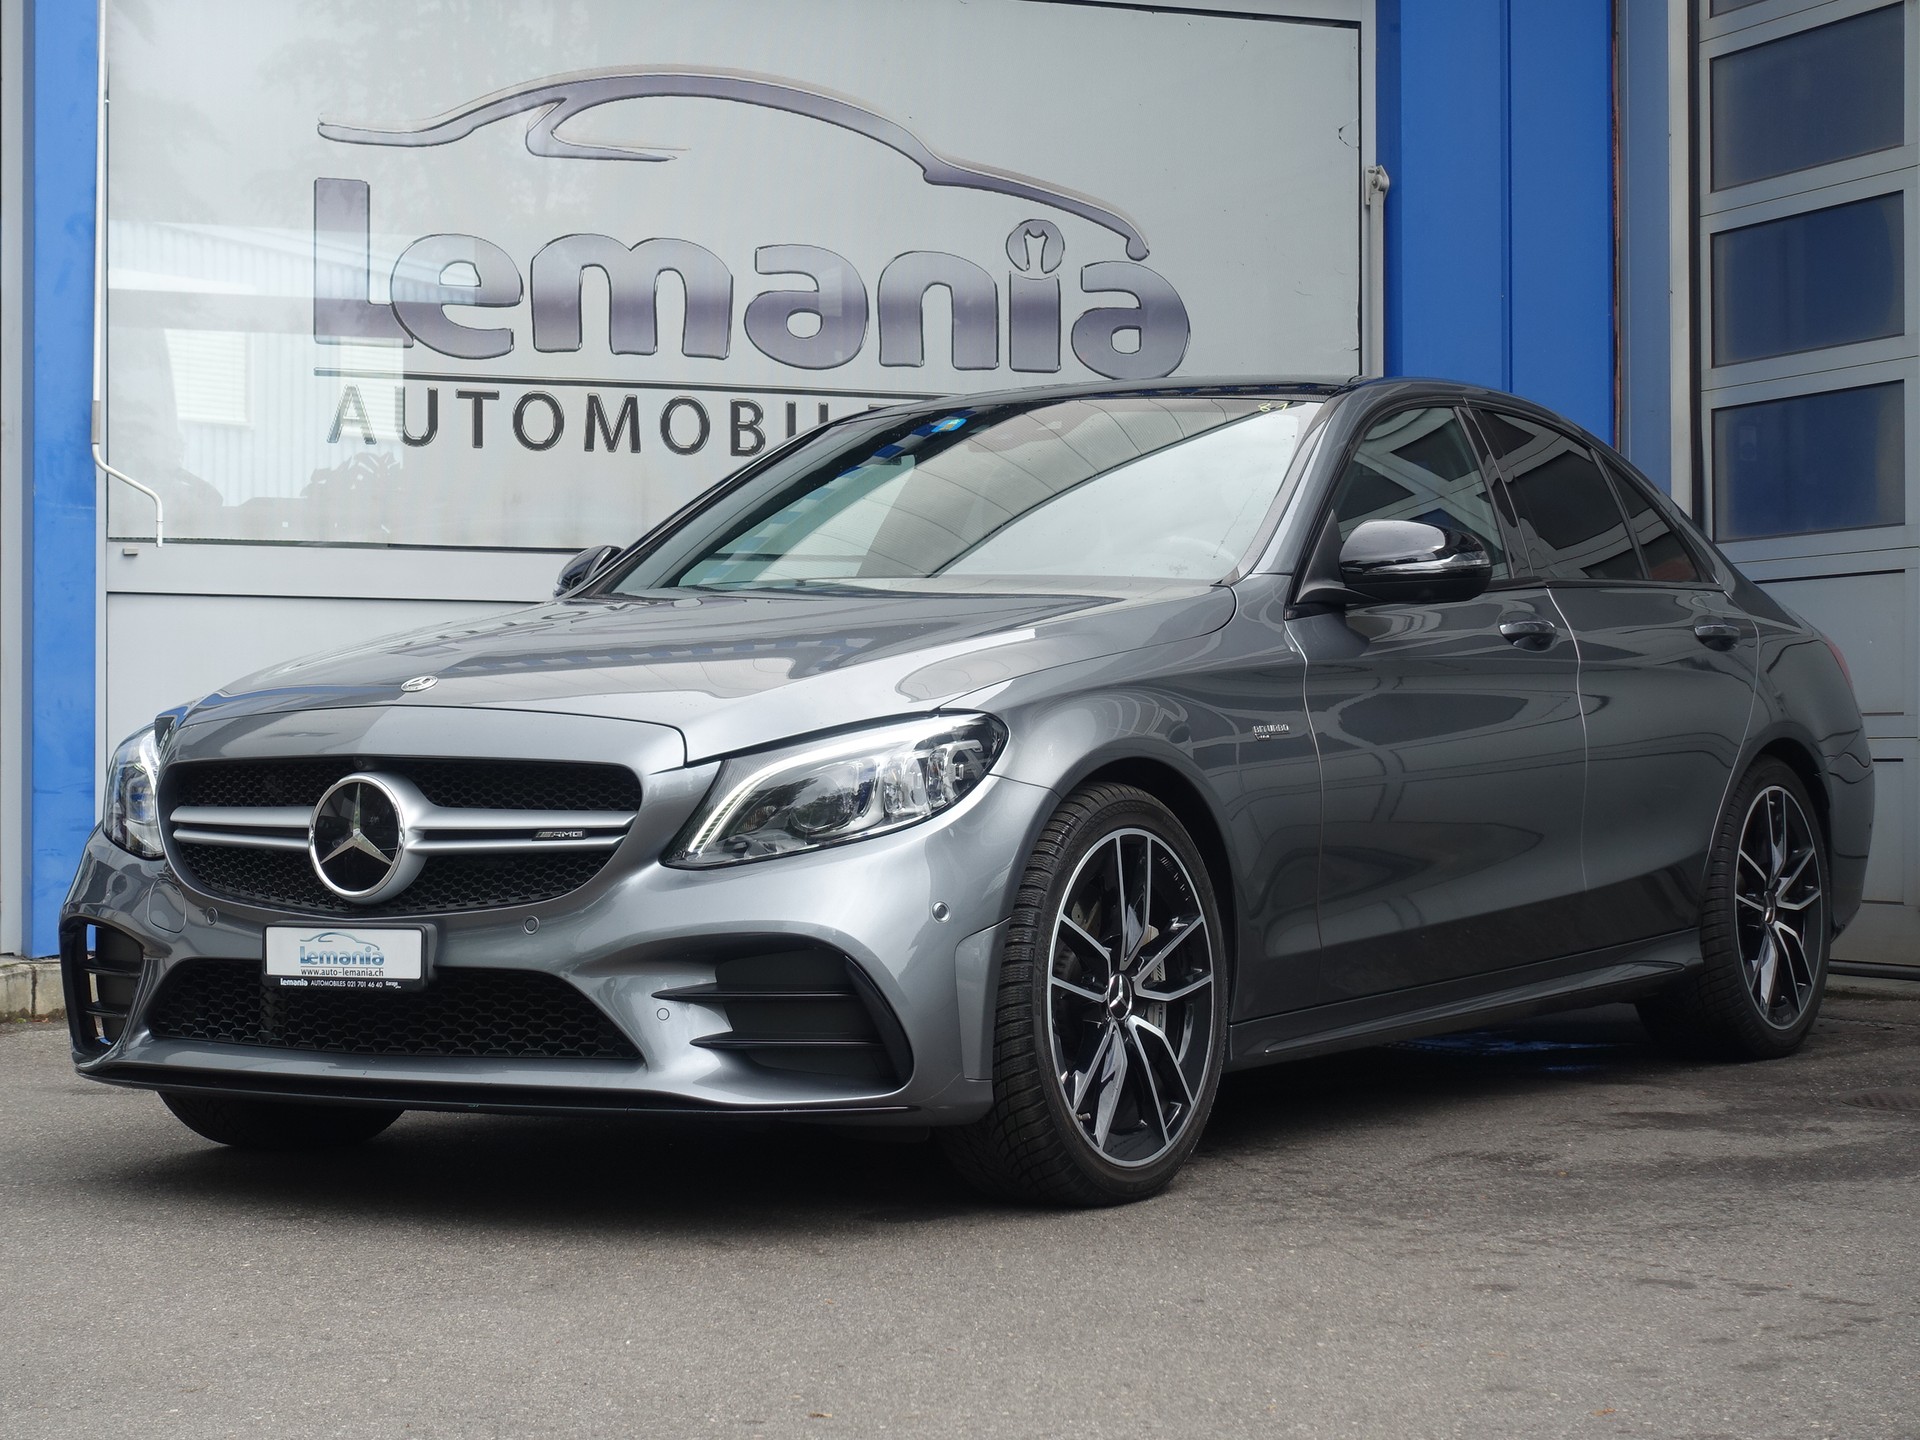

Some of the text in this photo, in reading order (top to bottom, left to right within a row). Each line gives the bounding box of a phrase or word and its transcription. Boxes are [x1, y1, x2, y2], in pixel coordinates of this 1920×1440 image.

[314, 177, 1191, 380] Lemania
[300, 946, 384, 965] Lemania
[301, 967, 384, 977] www.auto-lemania.ch
[311, 979, 346, 987] AUTOMOBILES
